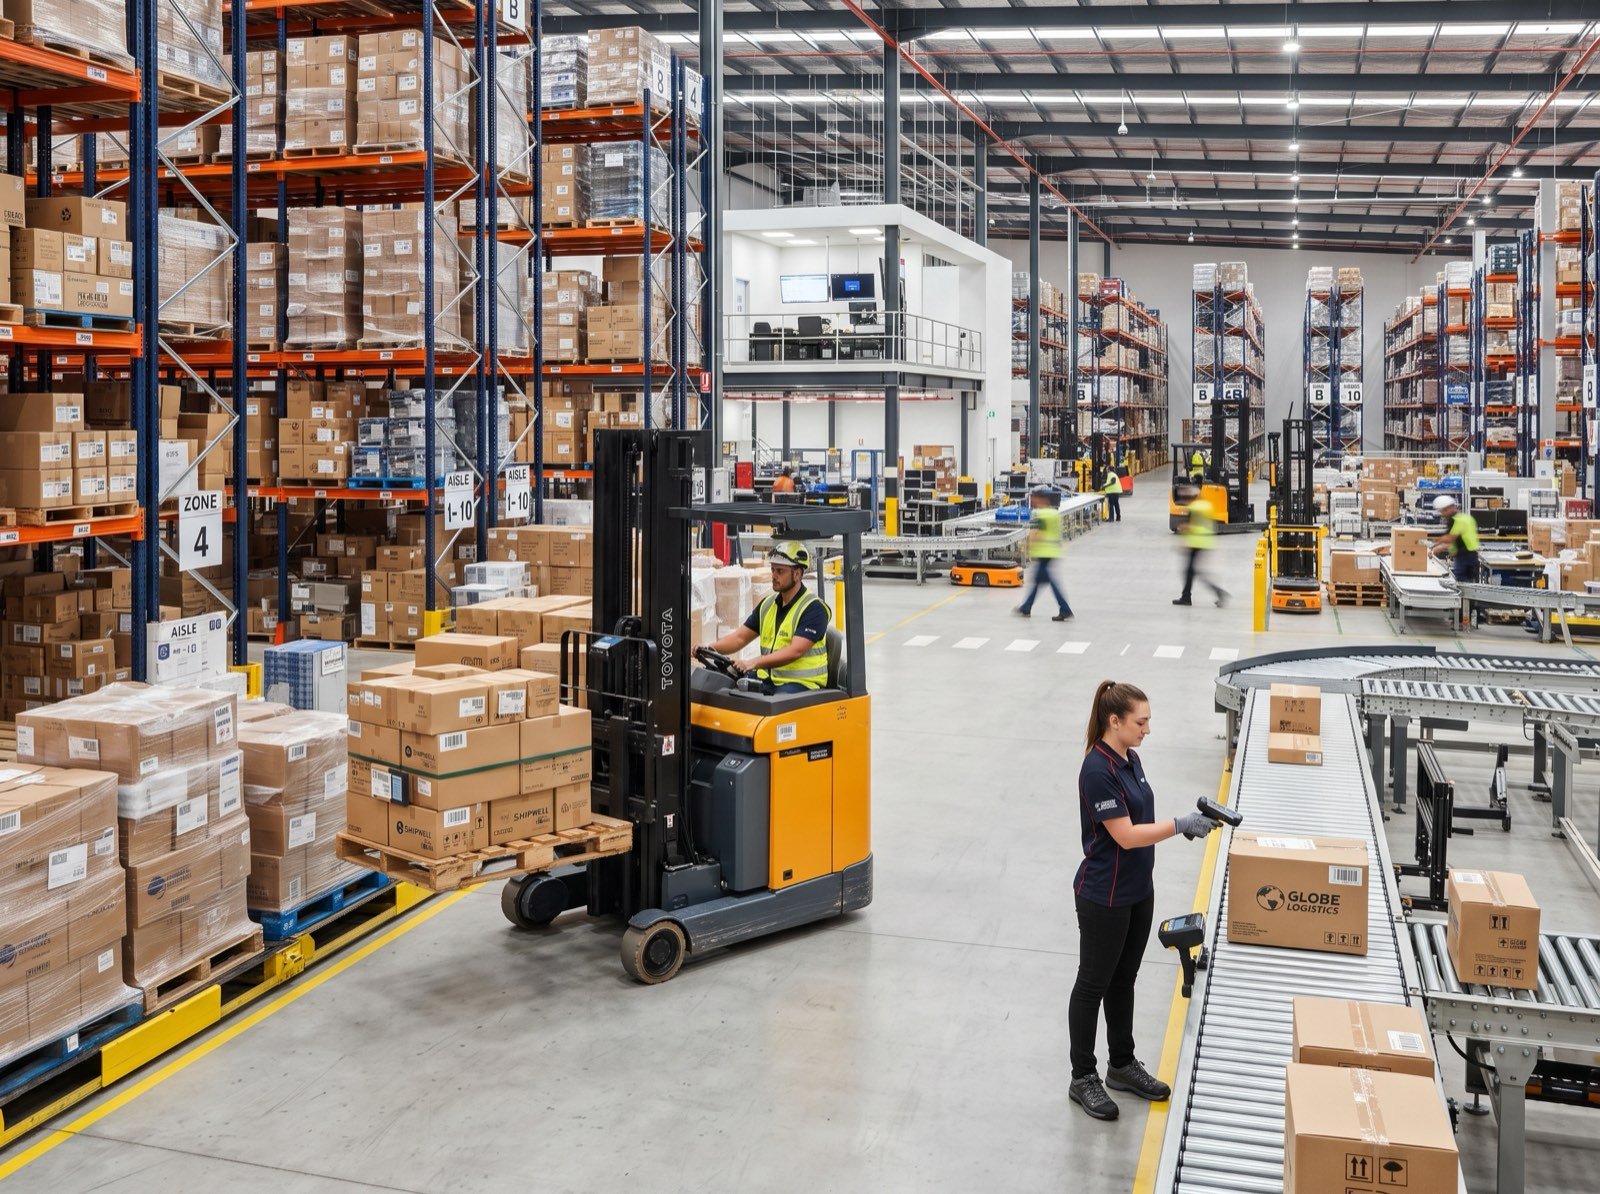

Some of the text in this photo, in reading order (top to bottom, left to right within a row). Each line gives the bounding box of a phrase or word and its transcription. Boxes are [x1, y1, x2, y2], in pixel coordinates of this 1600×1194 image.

[657, 69, 664, 94] 8
[690, 86, 697, 108] 4
[1199, 390, 1207, 400] B
[1315, 390, 1324, 401] B
[1347, 390, 1361, 401] 10
[448, 474, 470, 487] AISLE
[508, 468, 527, 481] AISLE
[184, 494, 217, 512] ZONE
[193, 525, 209, 557] 4
[171, 623, 197, 638] AISLE
[661, 607, 674, 690] TOYOTA
[514, 807, 549, 822] SHIPWELL
[404, 825, 432, 840] SHIPWELL
[1288, 890, 1341, 906] GLOBE
[1286, 903, 1339, 915] LOGISTICS
